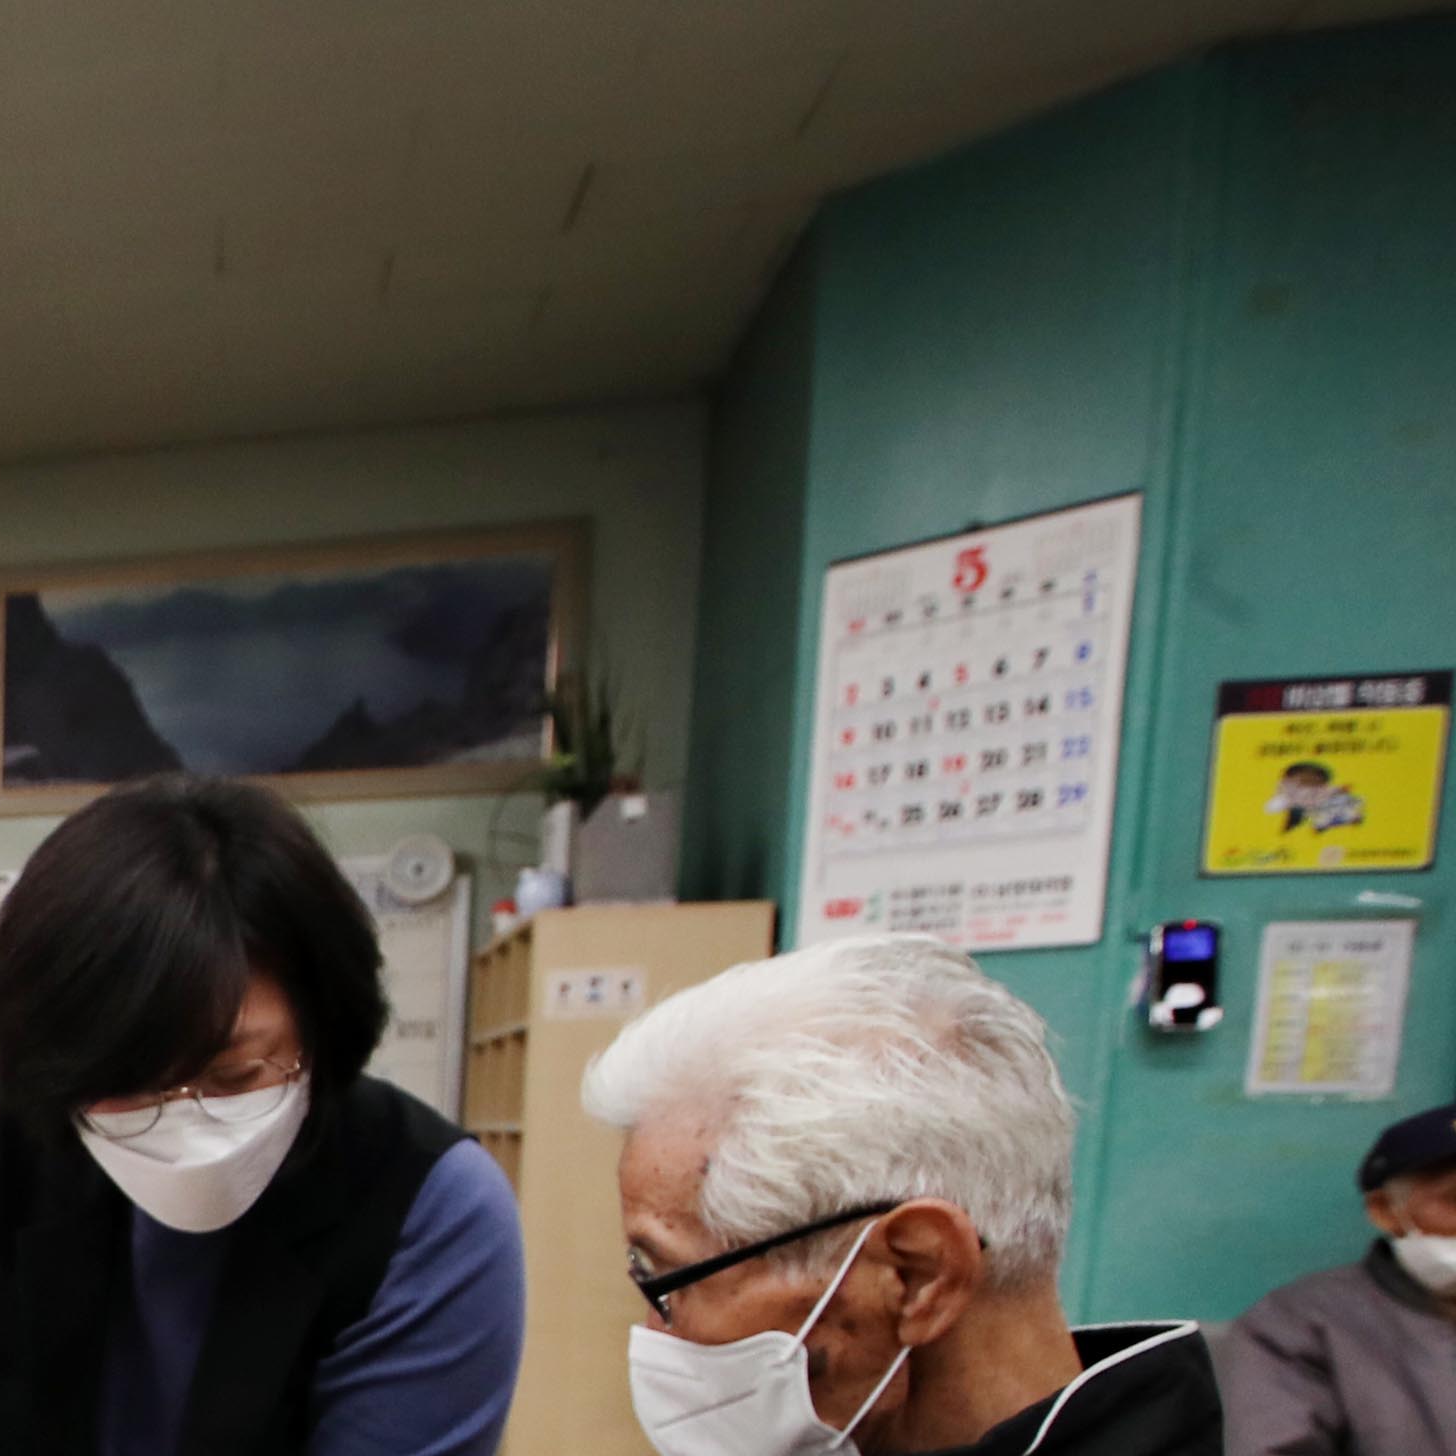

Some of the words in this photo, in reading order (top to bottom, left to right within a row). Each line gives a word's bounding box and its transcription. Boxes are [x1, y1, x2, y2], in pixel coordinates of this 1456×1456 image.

[952, 545, 990, 593] 5
[954, 663, 968, 685] 5
[993, 658, 1007, 677] 6
[1033, 648, 1049, 669] 7
[909, 715, 933, 734] 11
[945, 710, 971, 730] 12
[1023, 696, 1049, 717] 14
[868, 765, 891, 785] 17
[904, 761, 929, 780] 18
[943, 755, 967, 774] 19
[1020, 742, 1047, 765] 21
